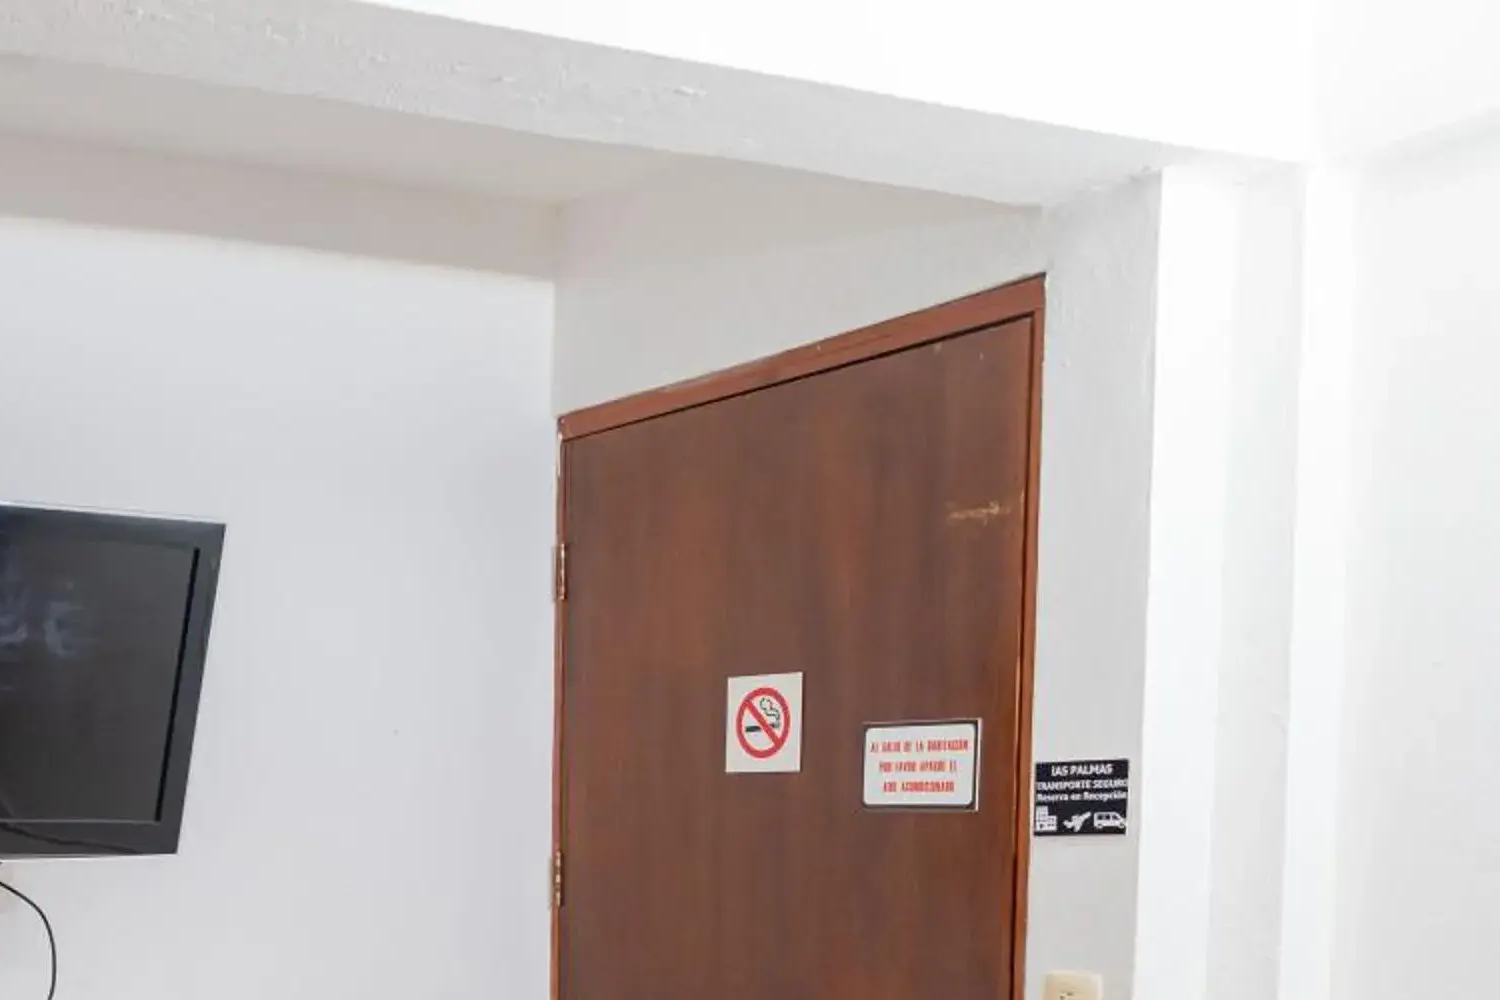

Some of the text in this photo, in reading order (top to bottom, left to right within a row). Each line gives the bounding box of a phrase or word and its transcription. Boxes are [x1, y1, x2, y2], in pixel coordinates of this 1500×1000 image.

[1051, 763, 1113, 776] LAS PALMAS
[1037, 781, 1091, 790] TRANSPORTE
